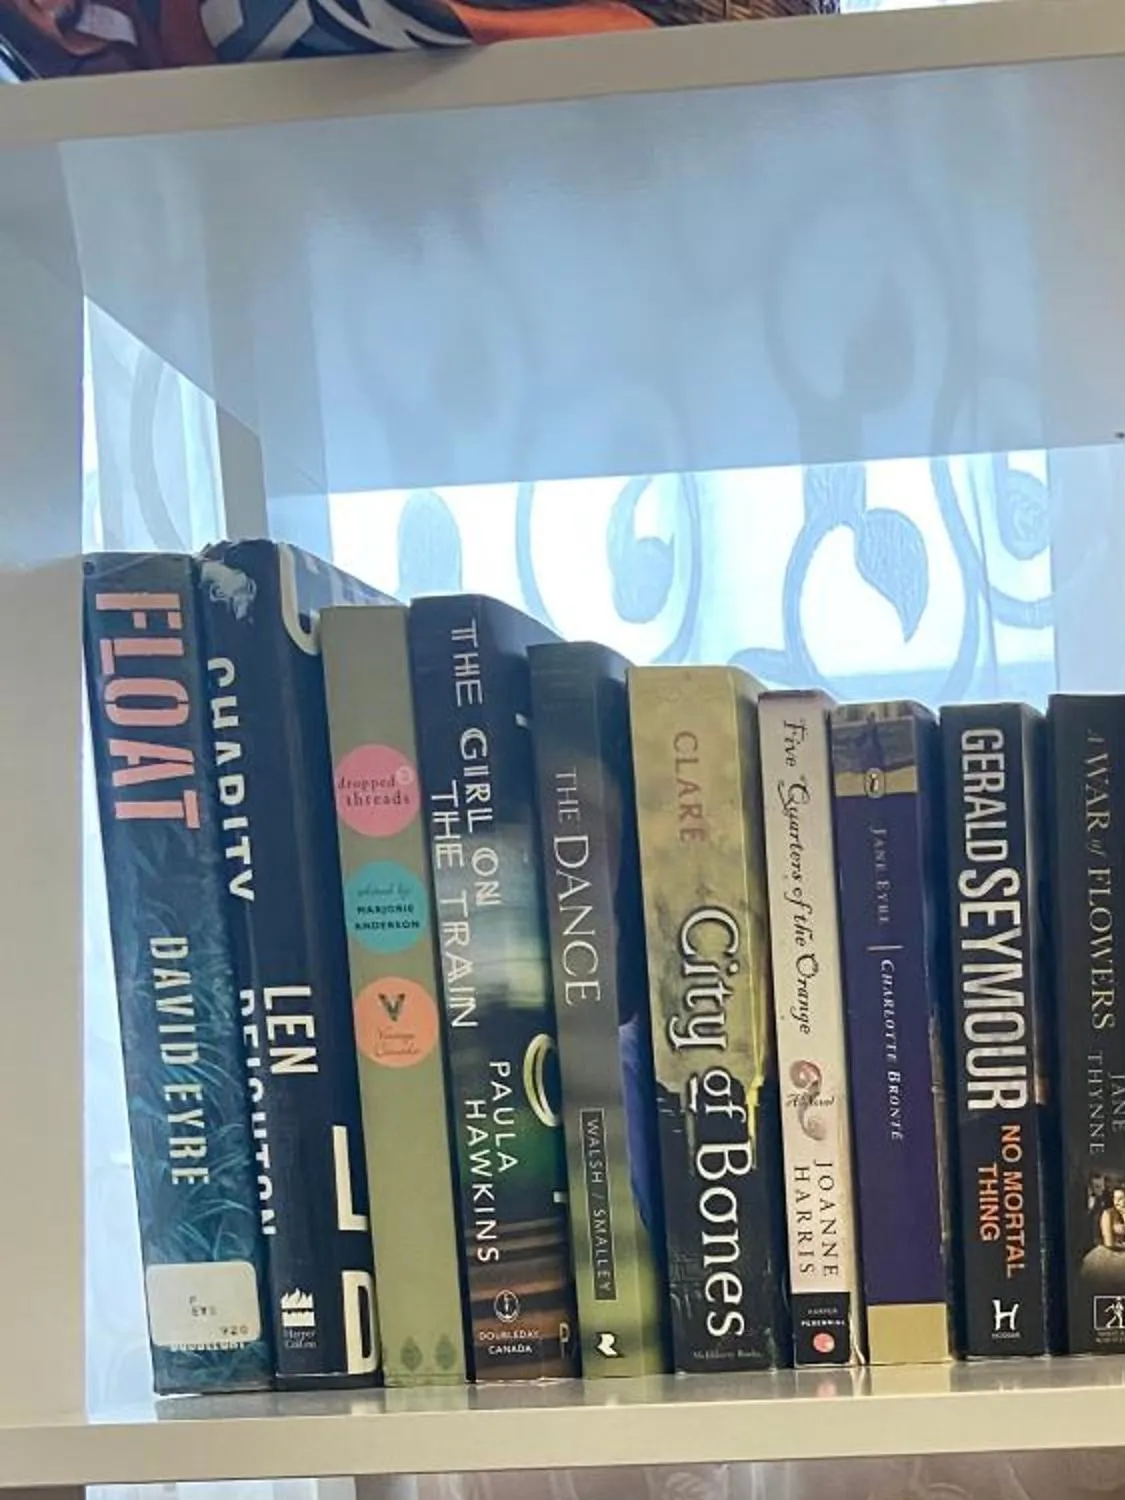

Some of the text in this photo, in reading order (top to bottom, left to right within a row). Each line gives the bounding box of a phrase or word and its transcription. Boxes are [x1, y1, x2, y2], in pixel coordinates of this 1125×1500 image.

[95, 592, 201, 829] FLOAT
[450, 618, 499, 906] THE GIRL ON
[338, 776, 396, 796] dropped
[346, 789, 410, 807] threads
[673, 731, 706, 843] CLARE
[1084, 753, 1111, 832] WAR
[431, 779, 479, 1029] THE TRAIN
[552, 767, 601, 1006] THE DANCE
[777, 719, 820, 1035] Five Quarters of the Orange
[869, 827, 888, 871] JANE
[354, 919, 421, 932] ANDERSON
[357, 904, 415, 915] MARJORIE
[958, 728, 1029, 1111] GERALD SEYMOUR
[1087, 868, 1116, 1030] FLOWERS
[149, 936, 210, 1185] DAVID EYRE
[263, 986, 319, 1074] LEN
[879, 958, 898, 1063] CHARLOTTE
[489, 1061, 519, 1173] PAULA
[667, 905, 752, 1338] City of Bones
[1086, 1051, 1106, 1155] THYNNE
[463, 1100, 500, 1264] HAWKINS
[585, 1118, 611, 1292] WALSH SMALLEY
[793, 1166, 815, 1276] HARRIS
[814, 1159, 839, 1278] JOANNE
[976, 1162, 1001, 1243] THING
[1001, 1124, 1026, 1280] NO MORTAL
[488, 1343, 533, 1354] CANADA
